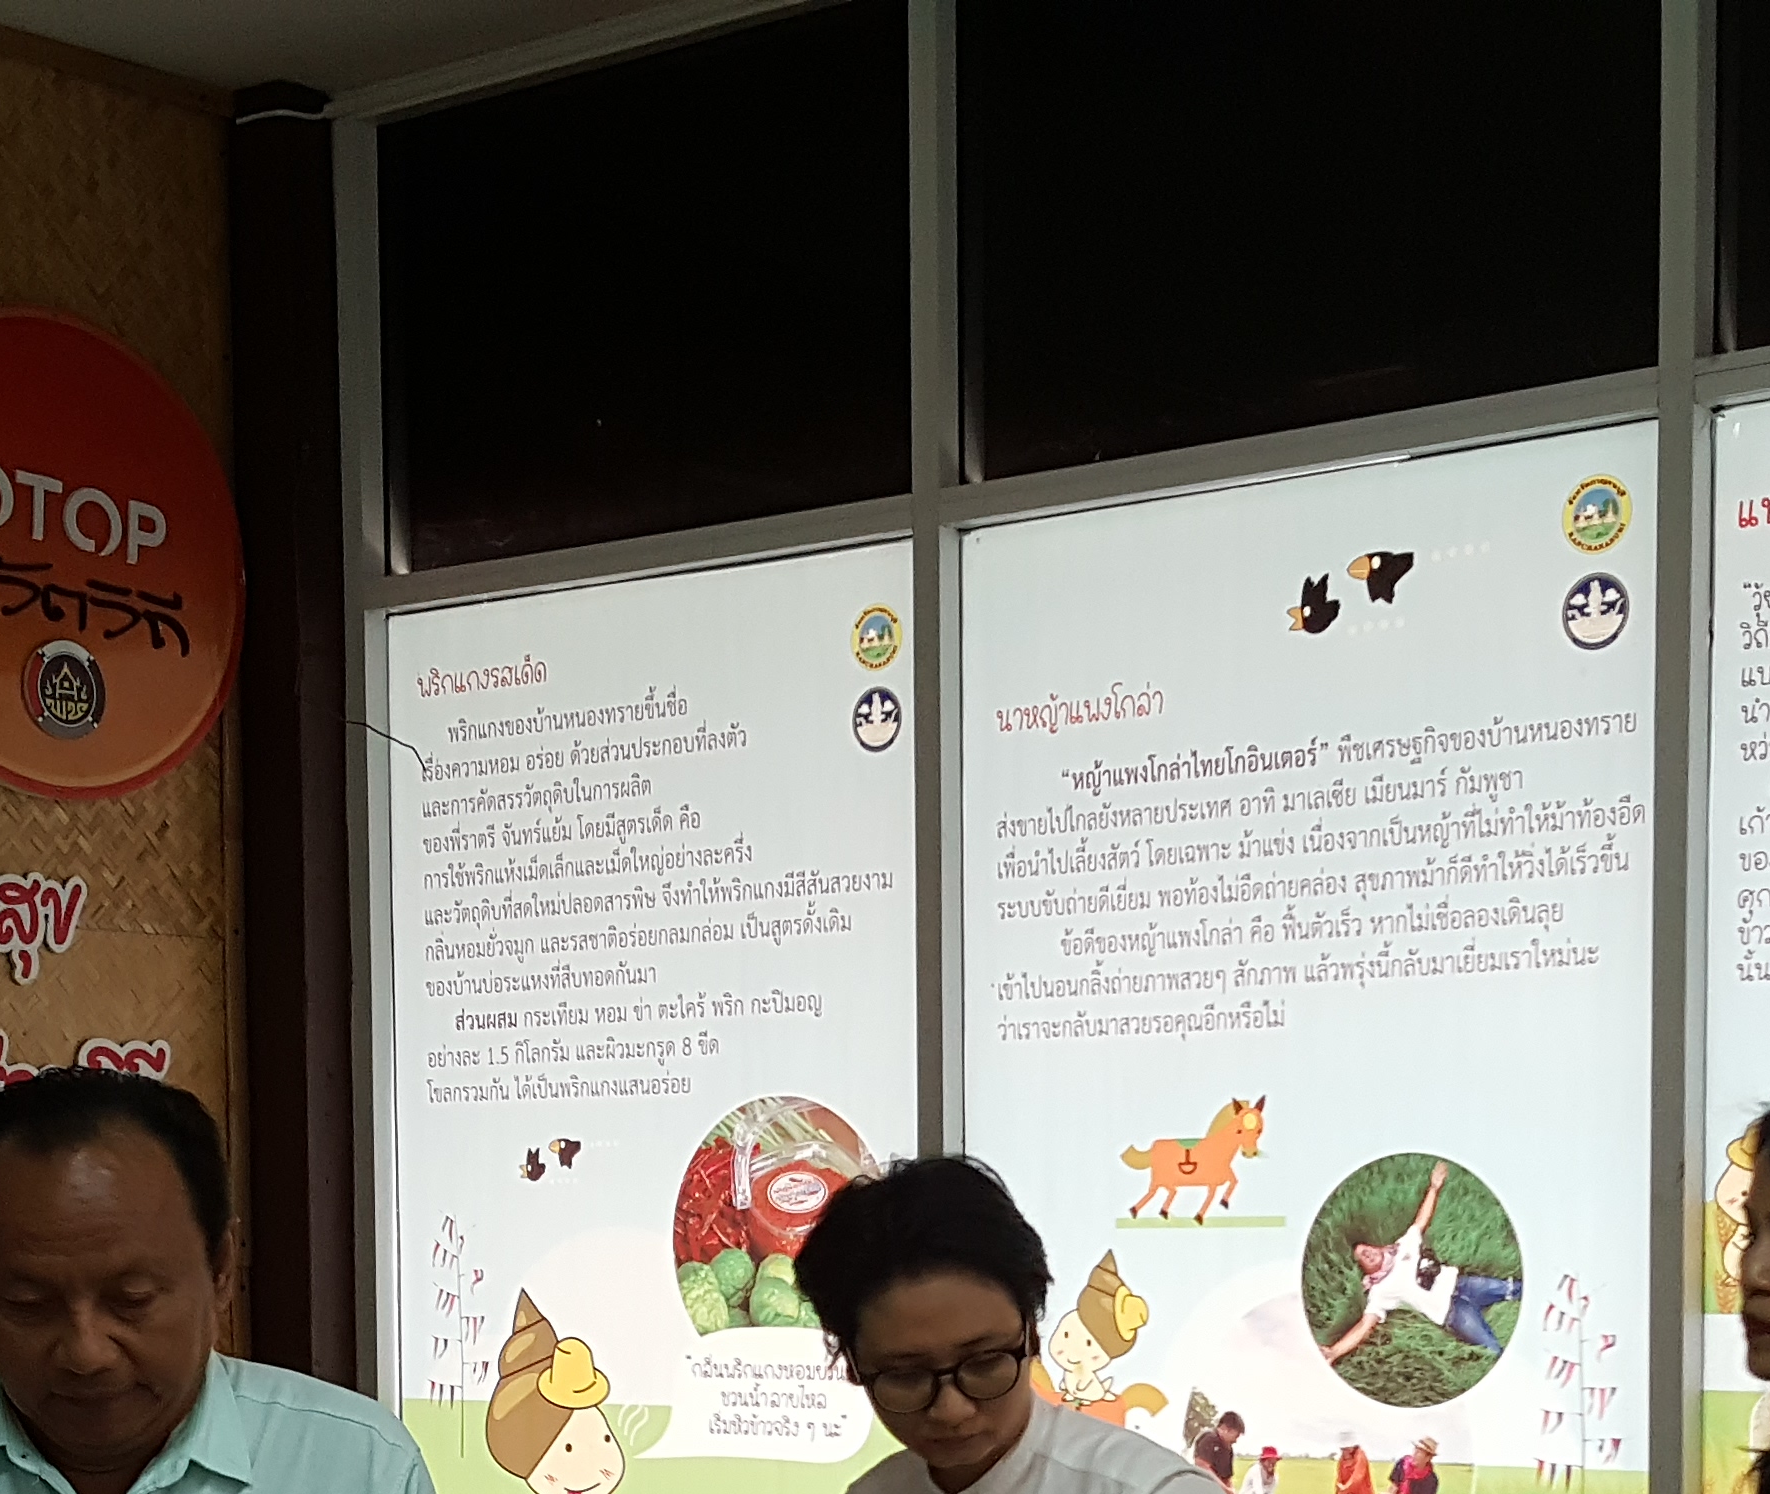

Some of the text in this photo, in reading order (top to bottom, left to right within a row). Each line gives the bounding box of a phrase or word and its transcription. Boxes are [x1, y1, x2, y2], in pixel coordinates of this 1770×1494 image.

[416, 653, 547, 698] พริกแกงรสเด็ด
[525, 745, 564, 771] อร่อย
[570, 719, 747, 766] ด้วยส่วนประกอบที่ลงตัว
[1239, 786, 1276, 817] อาทิ
[1282, 777, 1357, 813] มาเลเซีย
[1364, 766, 1448, 805] เมียนมาร์
[1455, 765, 1523, 803] กัมพูชา
[422, 803, 701, 855] ของพี่ราตรี จันทร์แย้ม โดยมีสูตรเด็ด คือ
[1145, 837, 1231, 867] โดยเฉพาะ
[1238, 827, 1295, 860] ม้าแข่ง
[425, 900, 852, 964] กลิ่นหอมยั่วจมูก และรสชาติอร่อยกลมกล่อม เป็นสูตรดั้งเดิม
[1250, 914, 1275, 943] คือ
[1281, 903, 1362, 941] ฟื้นตัวเร็ว
[1233, 958, 1297, 988] สักภาพ
[455, 1007, 518, 1031] ส่วนผสม
[523, 1001, 589, 1028] กระเทียม
[594, 1006, 627, 1024] หอม
[633, 996, 652, 1022] ข่า
[711, 991, 744, 1017] พริก
[750, 988, 823, 1018] กะปิมอญ
[427, 1029, 719, 1069] อย่างละ 1.5 กิโลกรัม และผิวมะกรูด 8 ขีด
[426, 1069, 691, 1104] โขลกรวมกัน ได้เป็นพริกแกงแสนอร่อย
